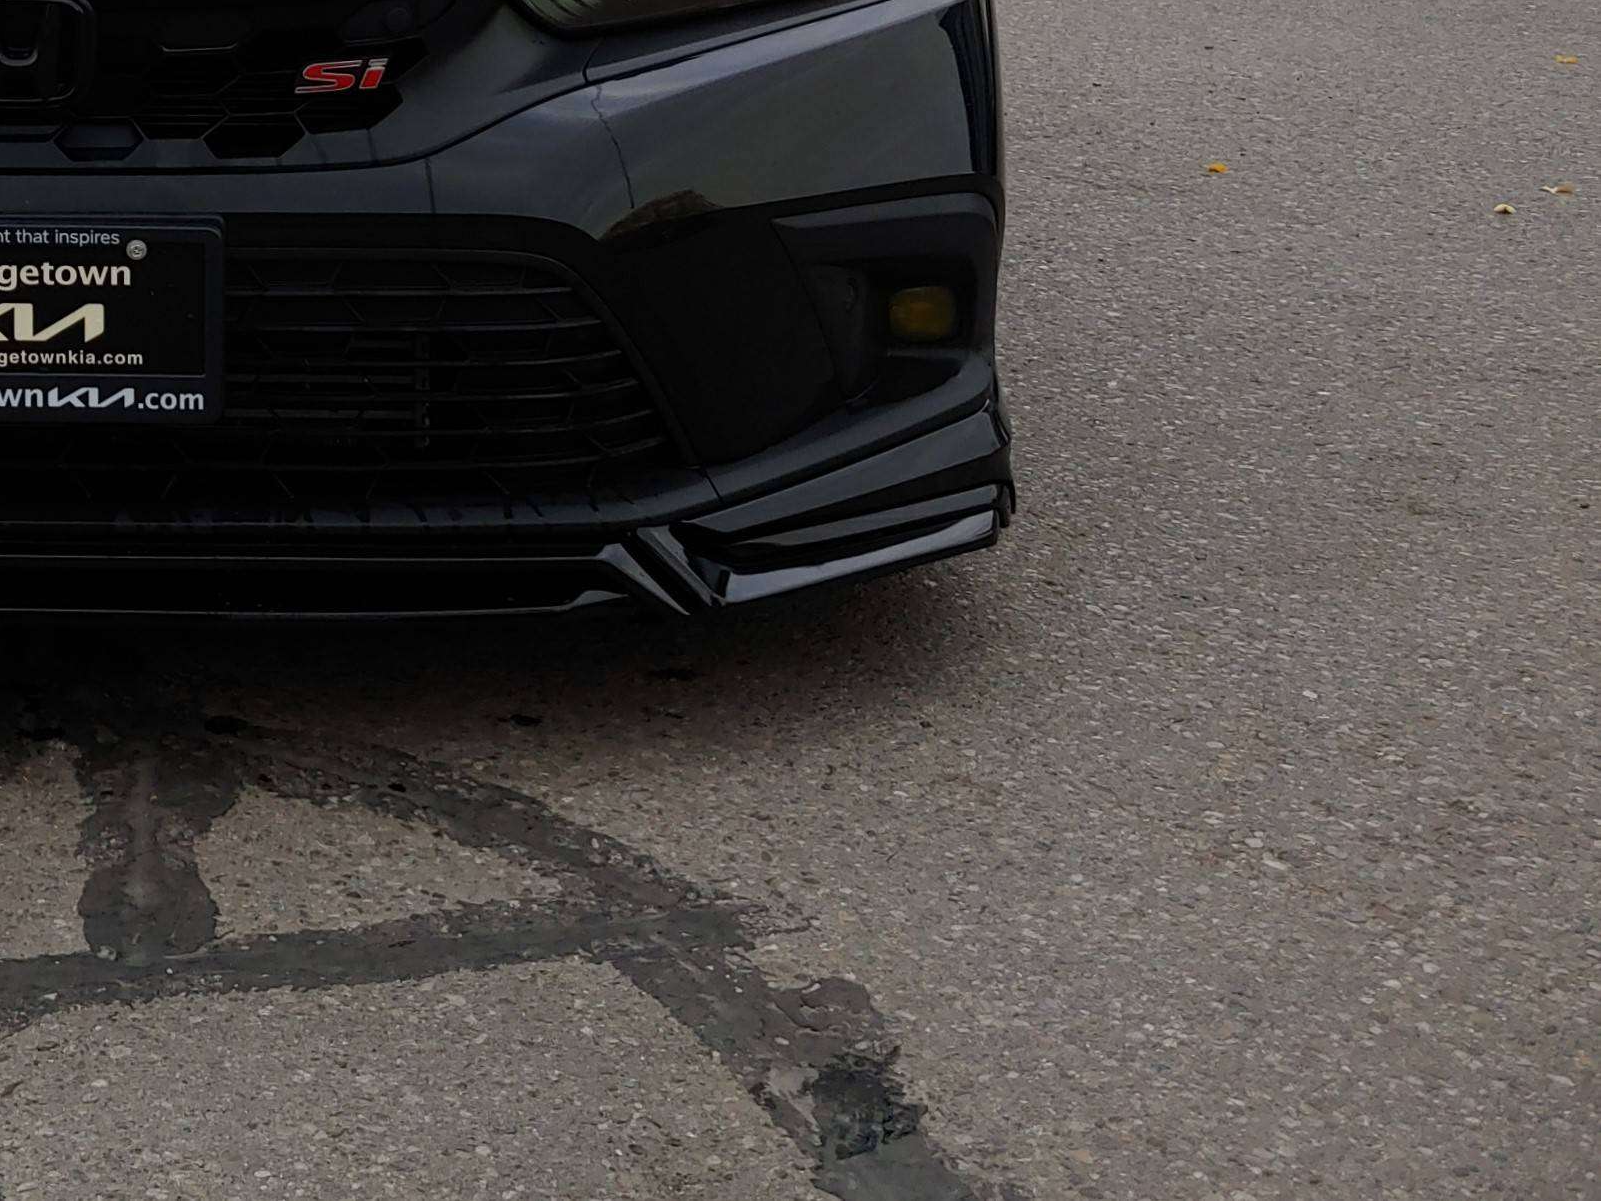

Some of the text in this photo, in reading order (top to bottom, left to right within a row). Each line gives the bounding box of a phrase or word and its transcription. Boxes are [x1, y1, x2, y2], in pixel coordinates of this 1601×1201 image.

[294, 57, 389, 94] Si
[15, 228, 49, 245] that
[54, 229, 120, 247] inspires
